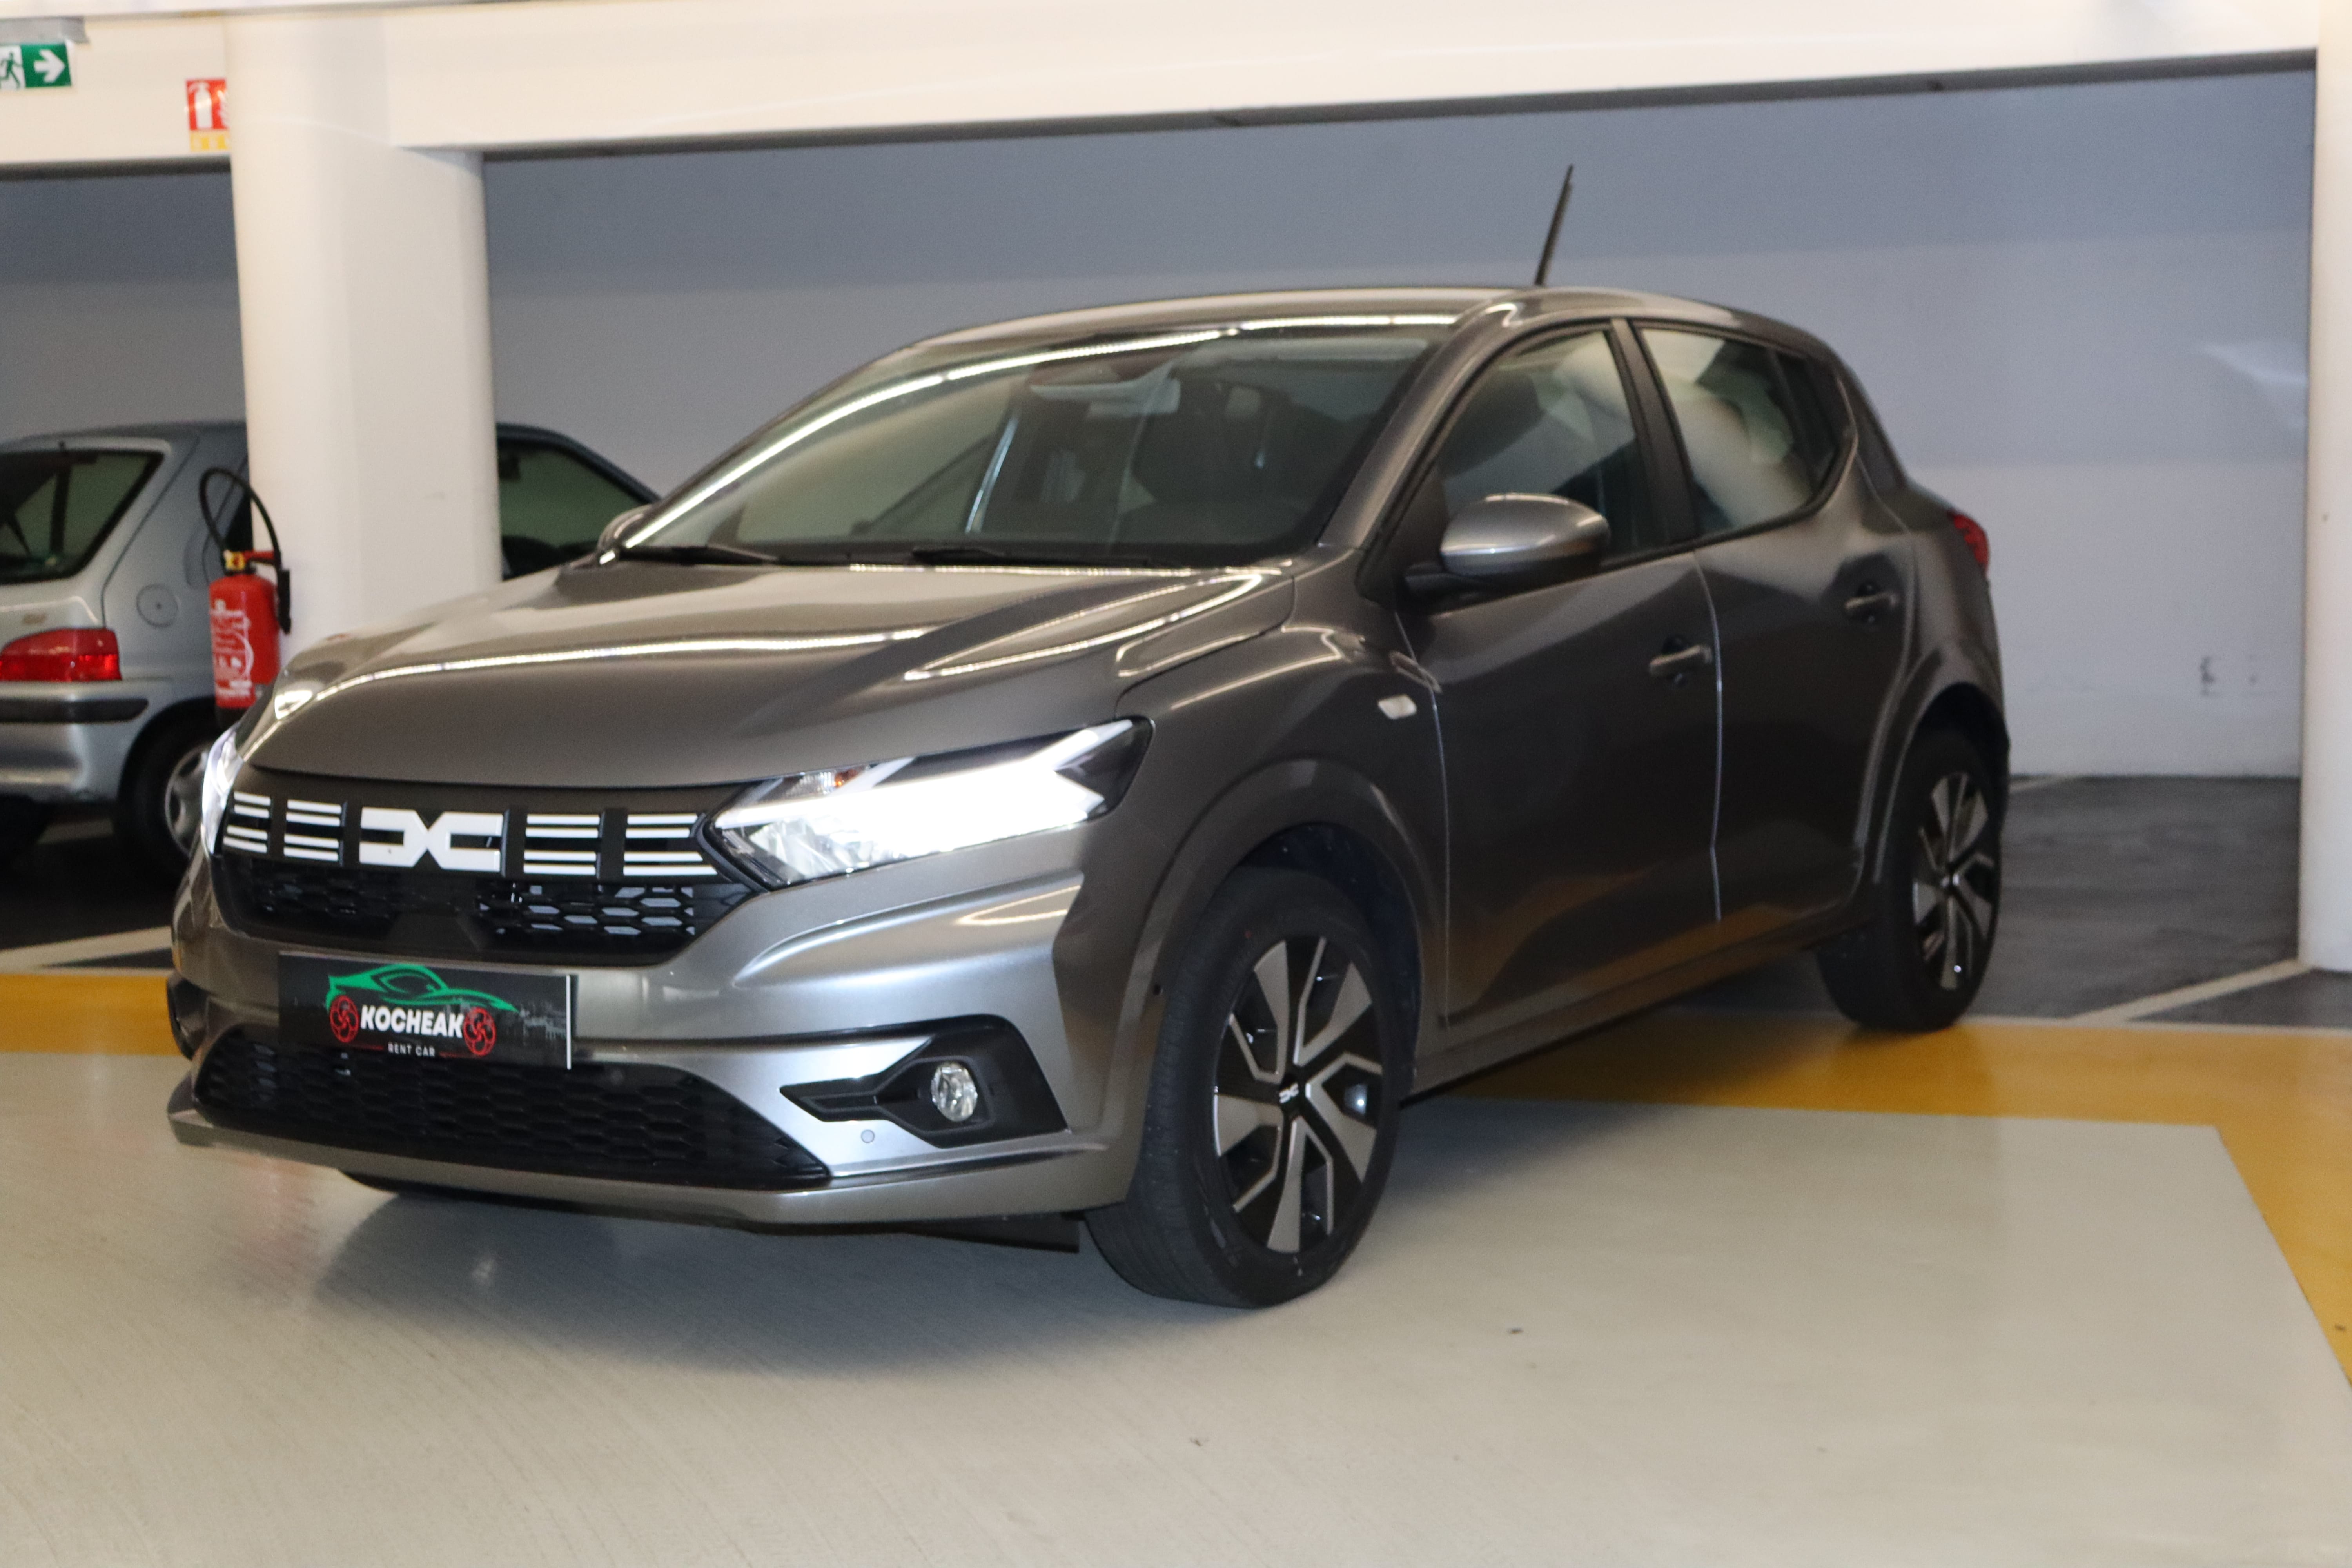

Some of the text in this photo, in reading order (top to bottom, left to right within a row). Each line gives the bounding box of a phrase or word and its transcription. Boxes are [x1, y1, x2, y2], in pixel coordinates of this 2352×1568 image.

[360, 1004, 465, 1038] KOCHEAK
[388, 1042, 435, 1057] RENT CAR
